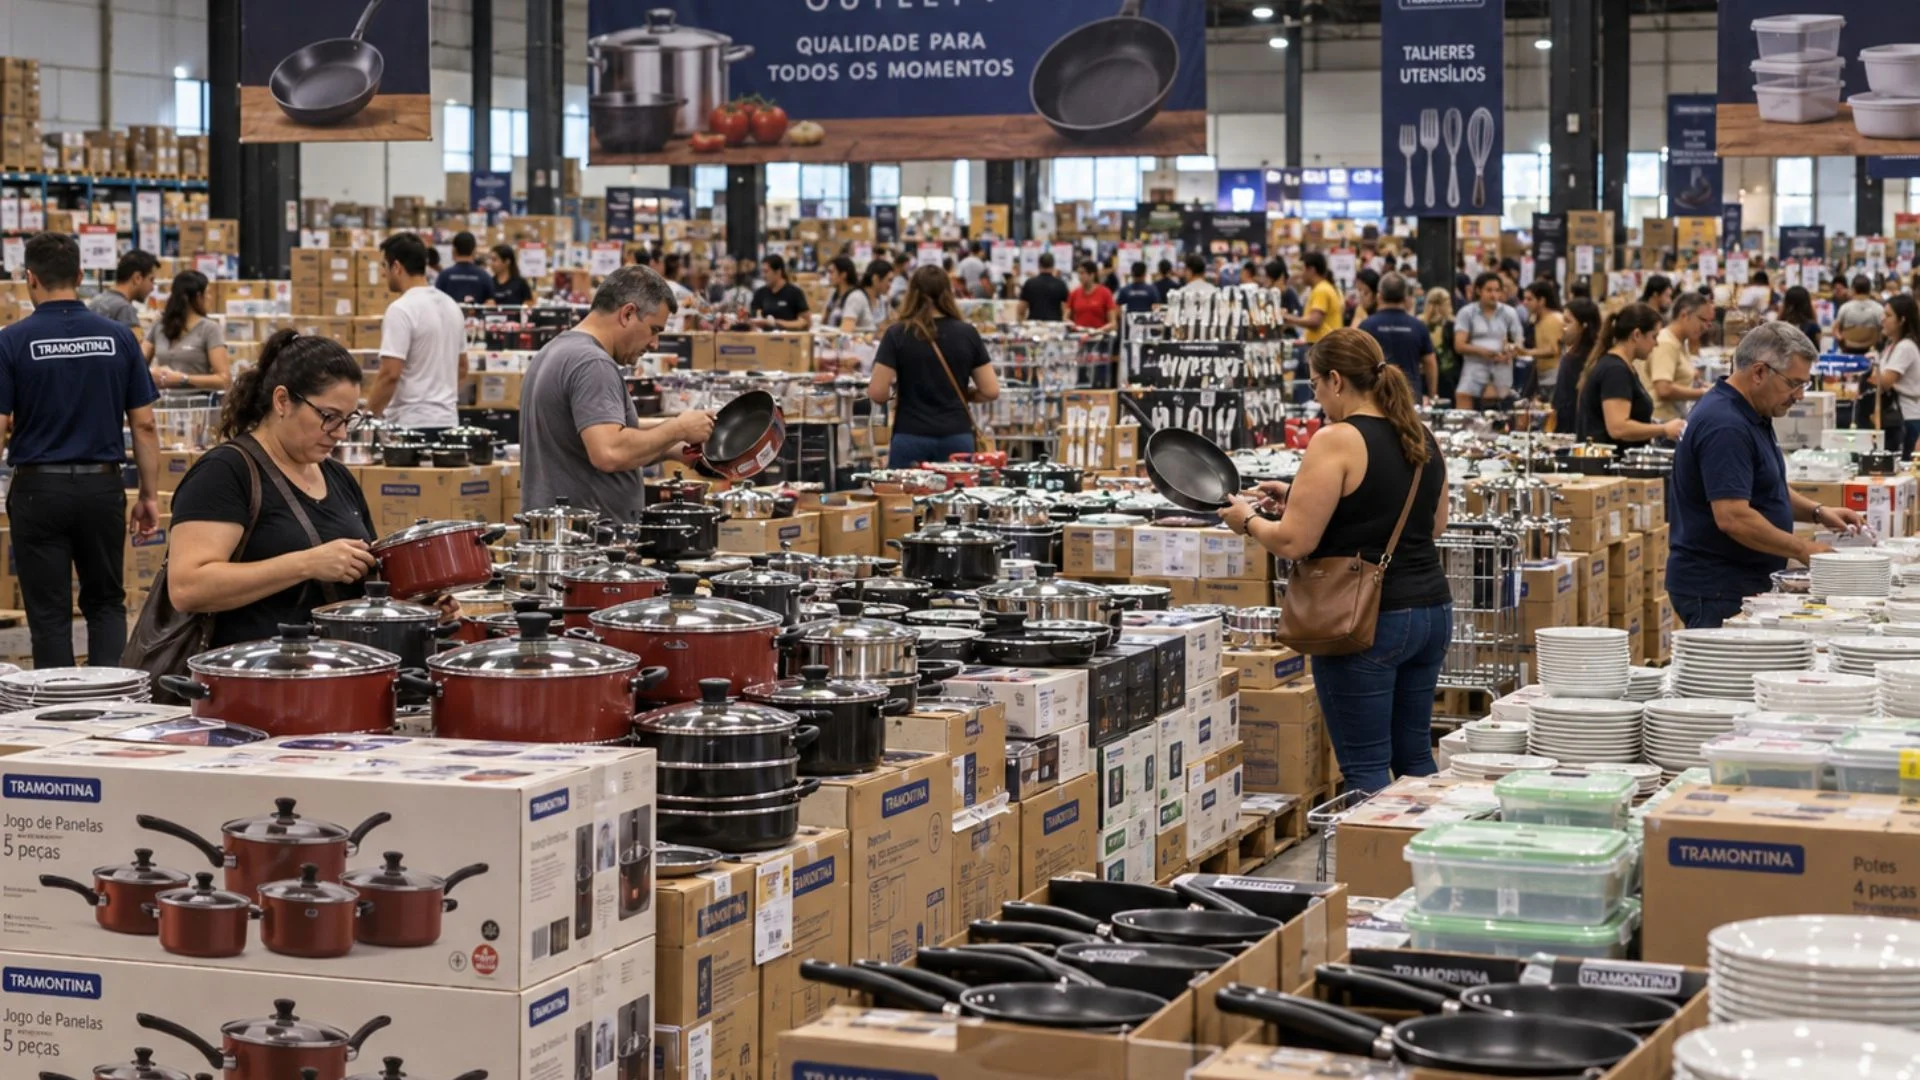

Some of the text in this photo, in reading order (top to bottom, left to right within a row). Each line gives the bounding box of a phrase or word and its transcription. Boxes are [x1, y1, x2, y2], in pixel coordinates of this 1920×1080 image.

[796, 31, 987, 56] QUALIDADE PARA
[1402, 44, 1476, 61] TALHERES
[767, 58, 1015, 82] TODOS OS MOMENTOS
[1400, 63, 1487, 84] UTENSÍLIOS
[37, 340, 111, 356] TRAMONTINA
[9, 780, 95, 798] TRAMONTINA
[3, 813, 104, 833] Jogo de Panelas
[3, 833, 61, 861] 5 peças
[1679, 844, 1795, 868] TRAMONTINA
[1853, 855, 1898, 875] Potes
[1853, 879, 1917, 901] 4 peças
[9, 973, 95, 994] TRAMONTINA
[1583, 970, 1677, 990] TRAMONTINA
[3, 1007, 104, 1031] Jogo de Panelas
[3, 1028, 61, 1059] 5 peças
